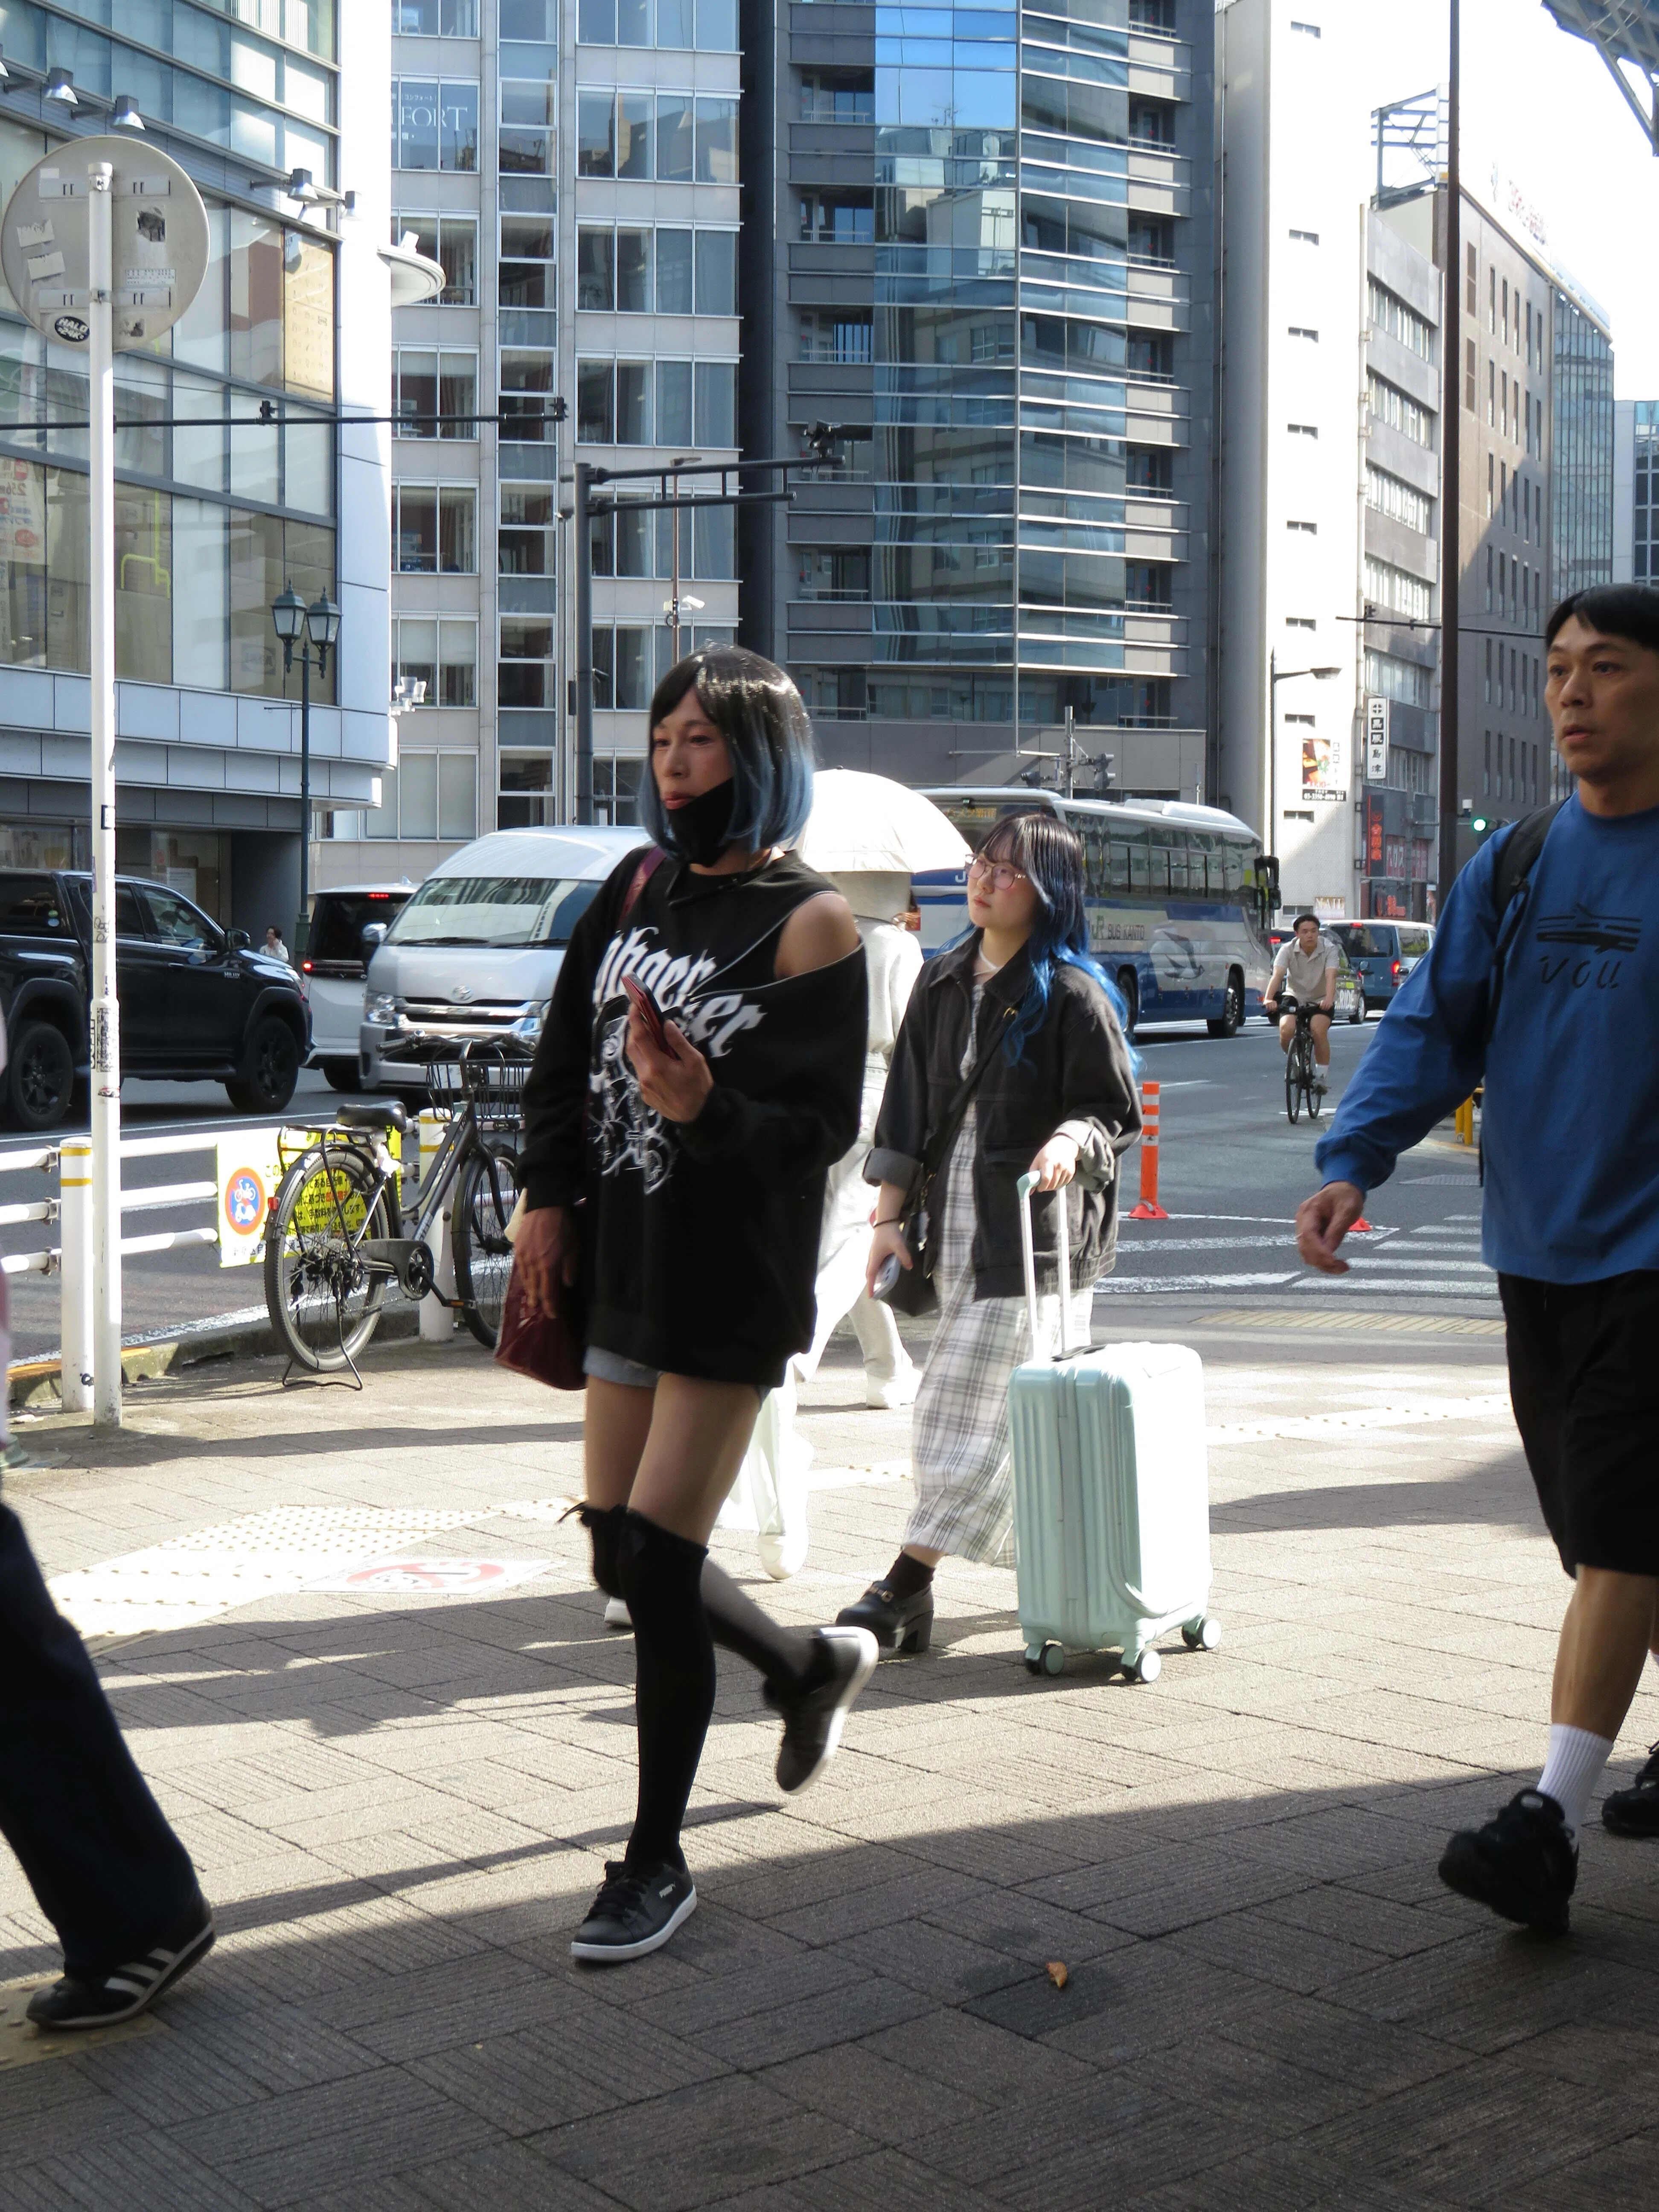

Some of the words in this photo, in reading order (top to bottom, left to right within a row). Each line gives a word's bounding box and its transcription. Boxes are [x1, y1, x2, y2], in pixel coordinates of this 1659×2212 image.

[392, 106, 468, 131] FORT
[58, 317, 88, 333] HALO
[1108, 923, 1121, 939] BUS
[1123, 924, 1145, 940] KANTO
